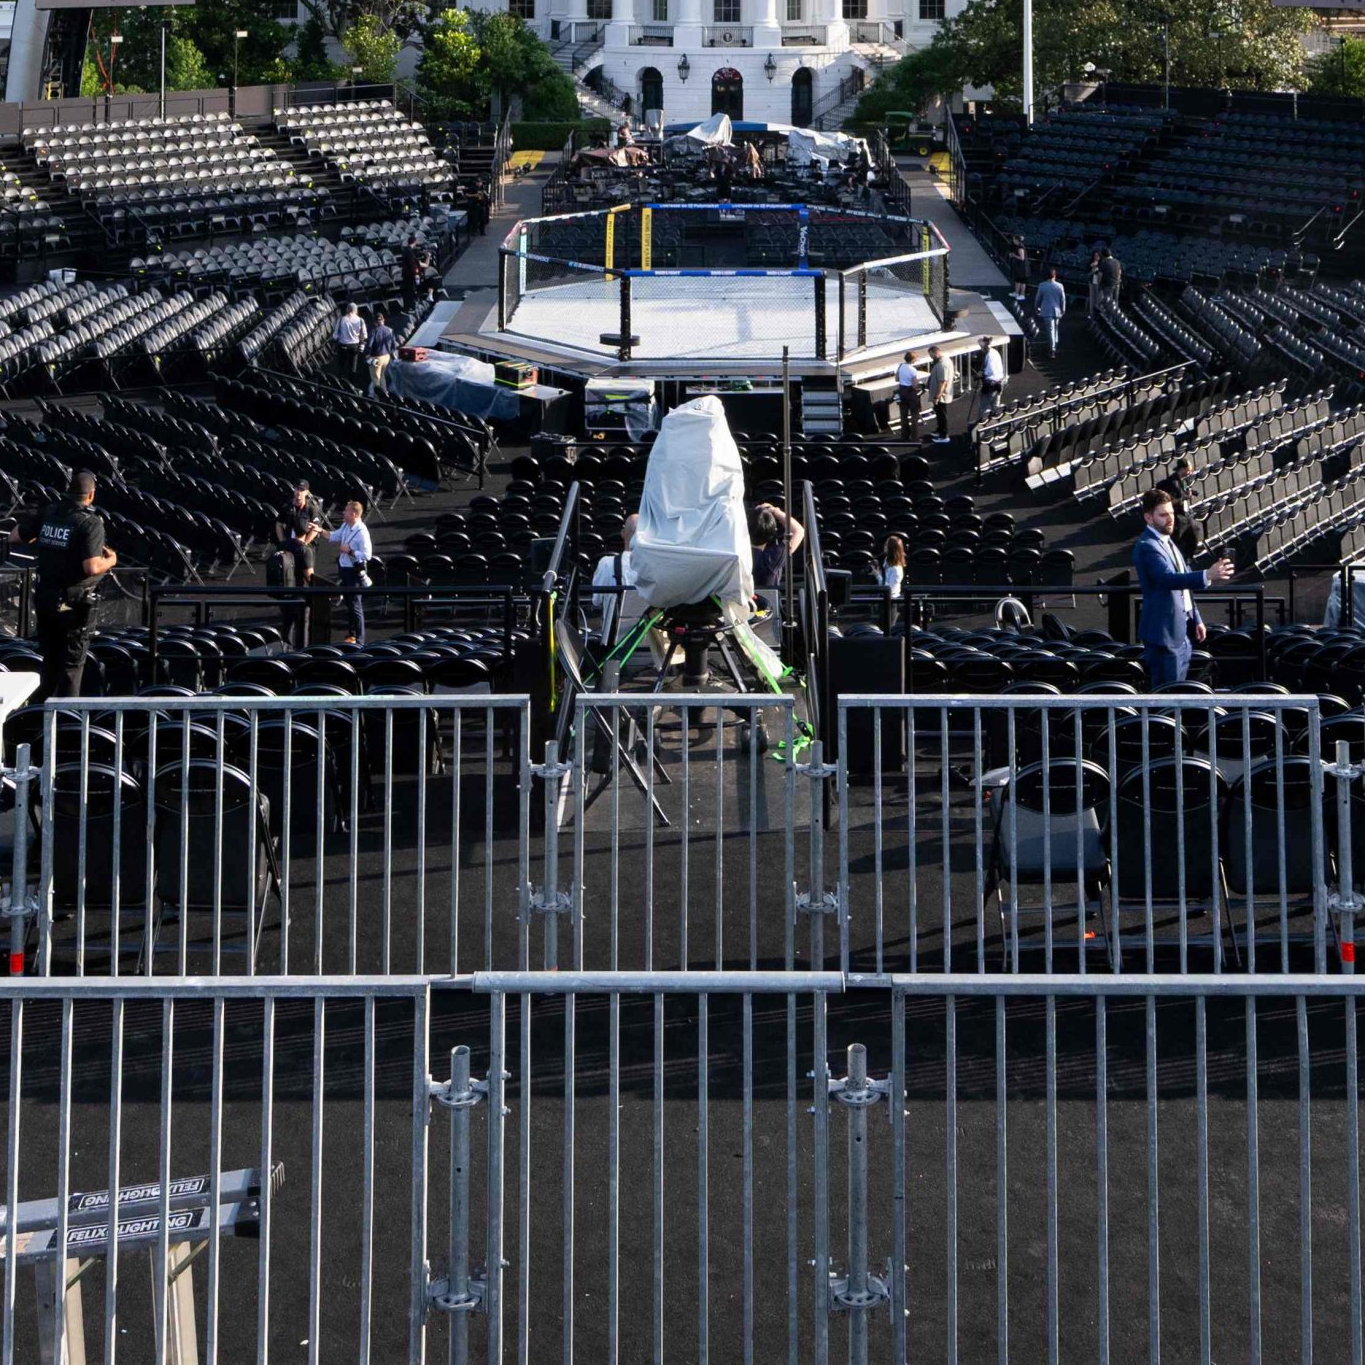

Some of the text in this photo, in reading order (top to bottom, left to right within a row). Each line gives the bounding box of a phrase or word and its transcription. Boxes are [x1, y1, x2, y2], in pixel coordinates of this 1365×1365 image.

[799, 226, 808, 257] VeChain
[40, 524, 70, 540] POLICE
[84, 1186, 151, 1206] LIGHING
[68, 1215, 188, 1242] FELIX LIGHTNG
